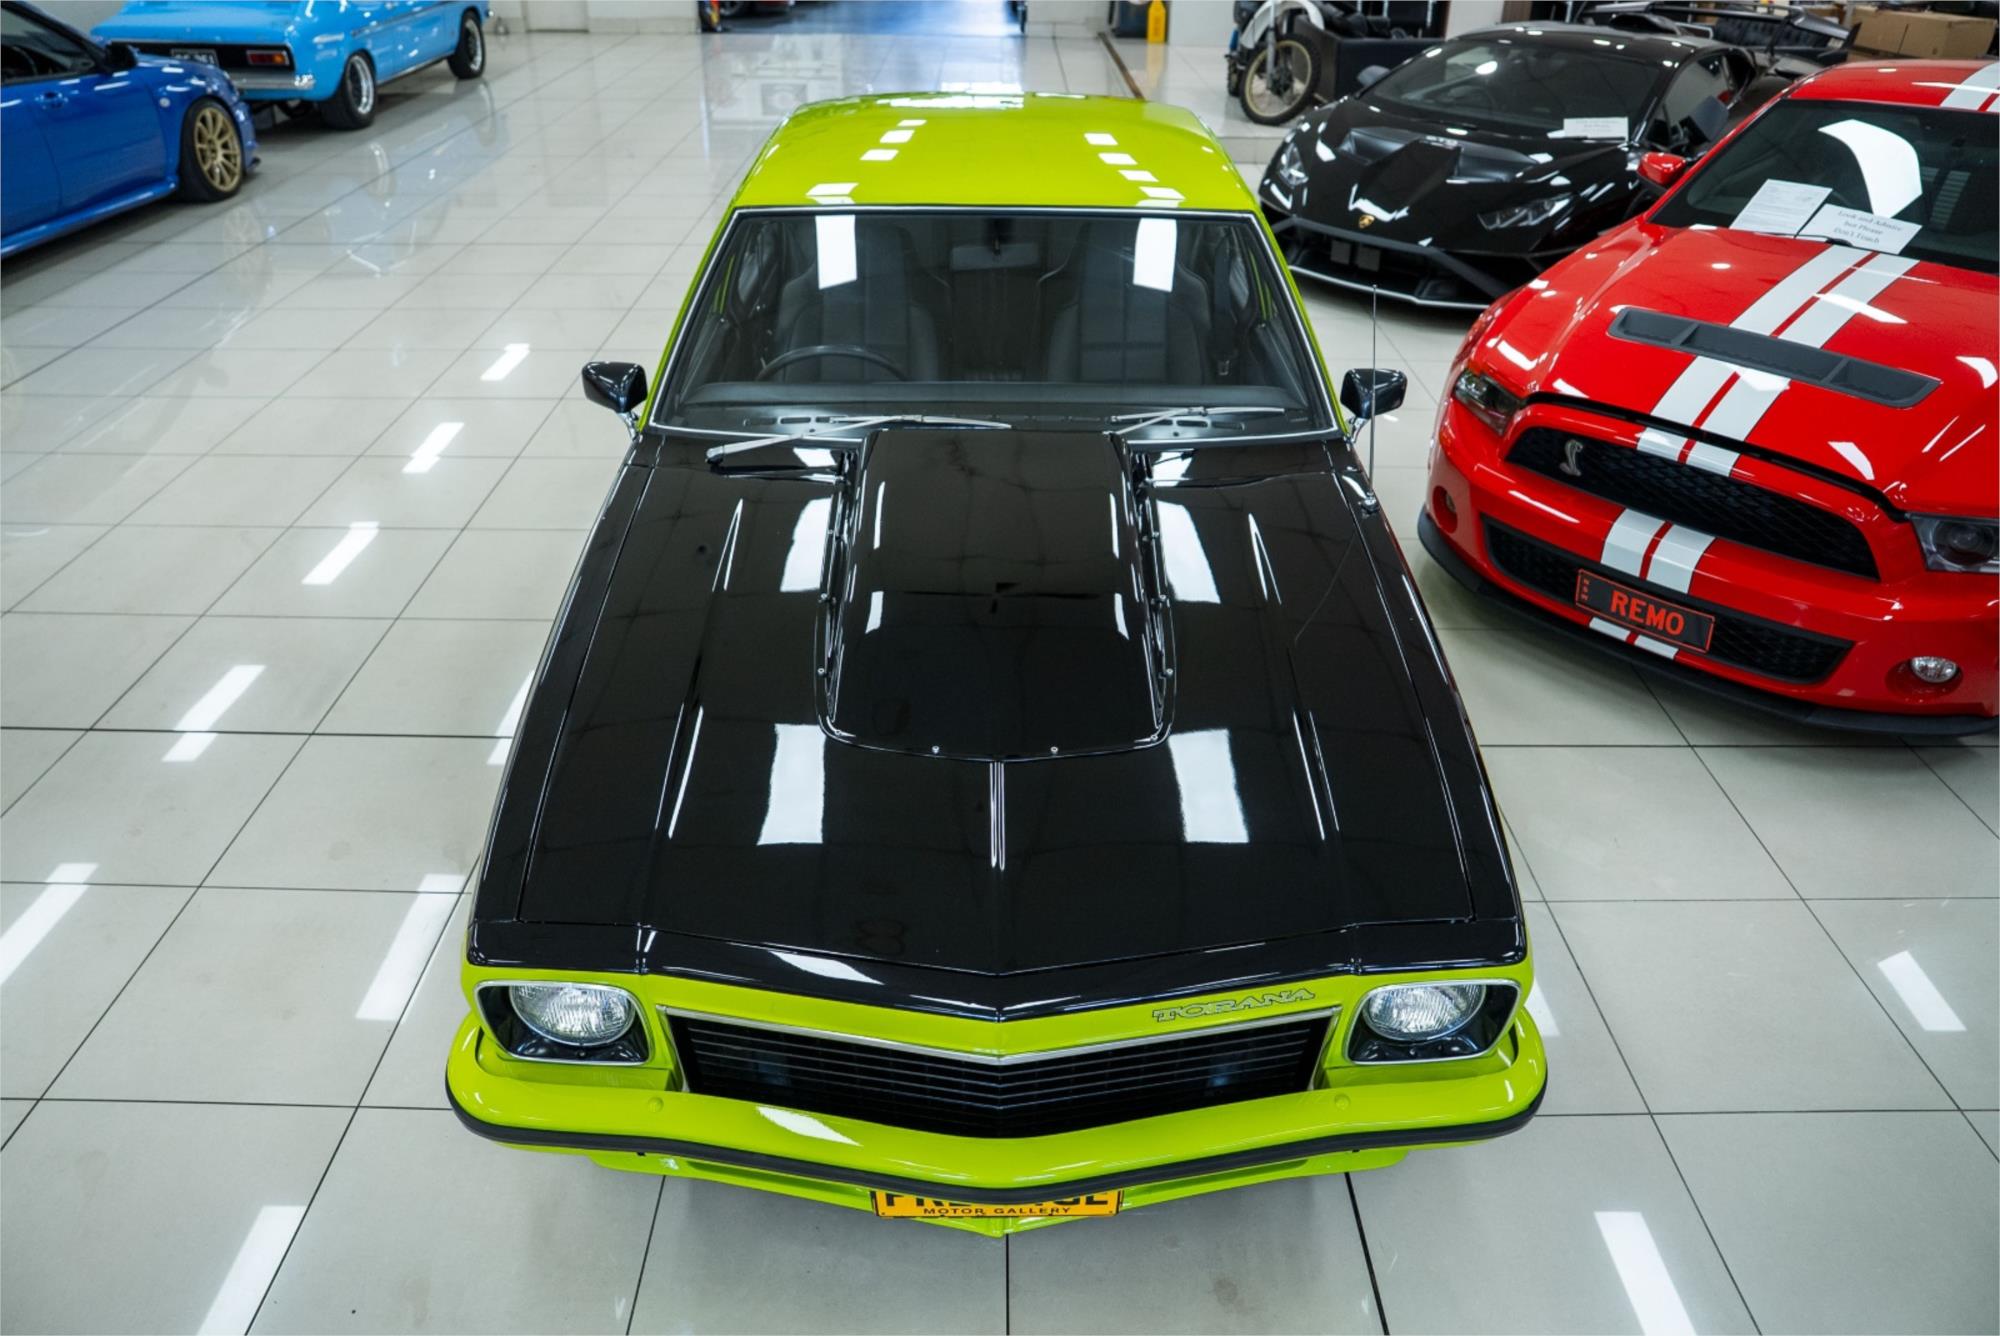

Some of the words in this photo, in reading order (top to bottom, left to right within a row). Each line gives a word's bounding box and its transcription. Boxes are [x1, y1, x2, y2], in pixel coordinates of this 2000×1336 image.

[1610, 590, 1685, 635] REMO
[1152, 988, 1316, 1022] TORANA
[993, 1207, 1071, 1215] GALLERY
